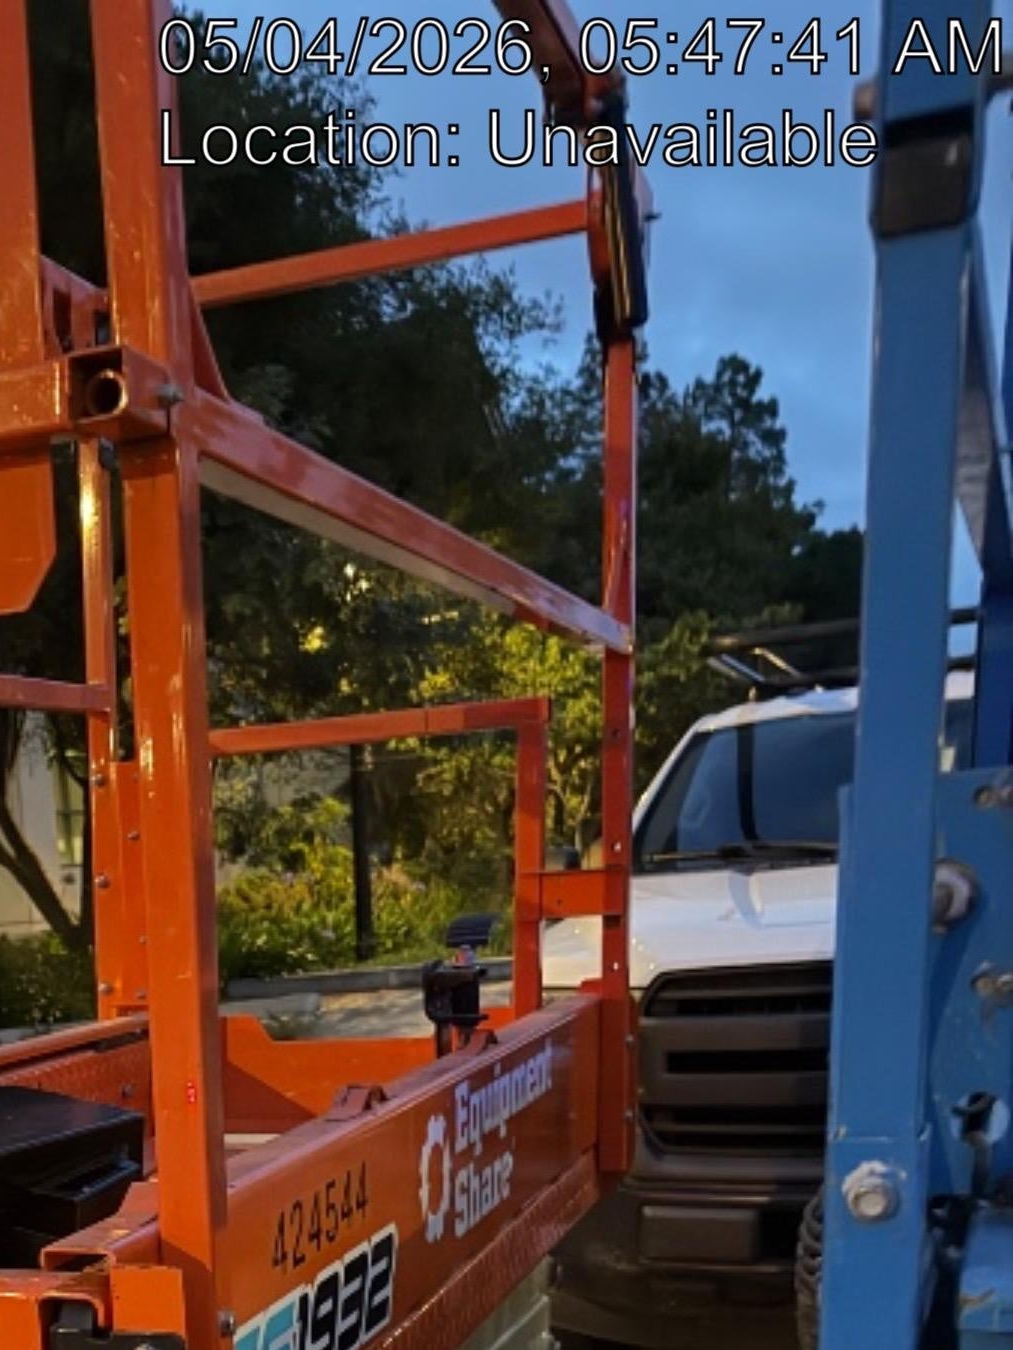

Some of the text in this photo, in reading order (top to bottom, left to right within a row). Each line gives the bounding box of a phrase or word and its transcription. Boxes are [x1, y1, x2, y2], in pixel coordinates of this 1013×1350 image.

[453, 1040, 553, 1155] Equipment
[272, 1161, 370, 1272] 424544
[453, 1149, 515, 1238] Share
